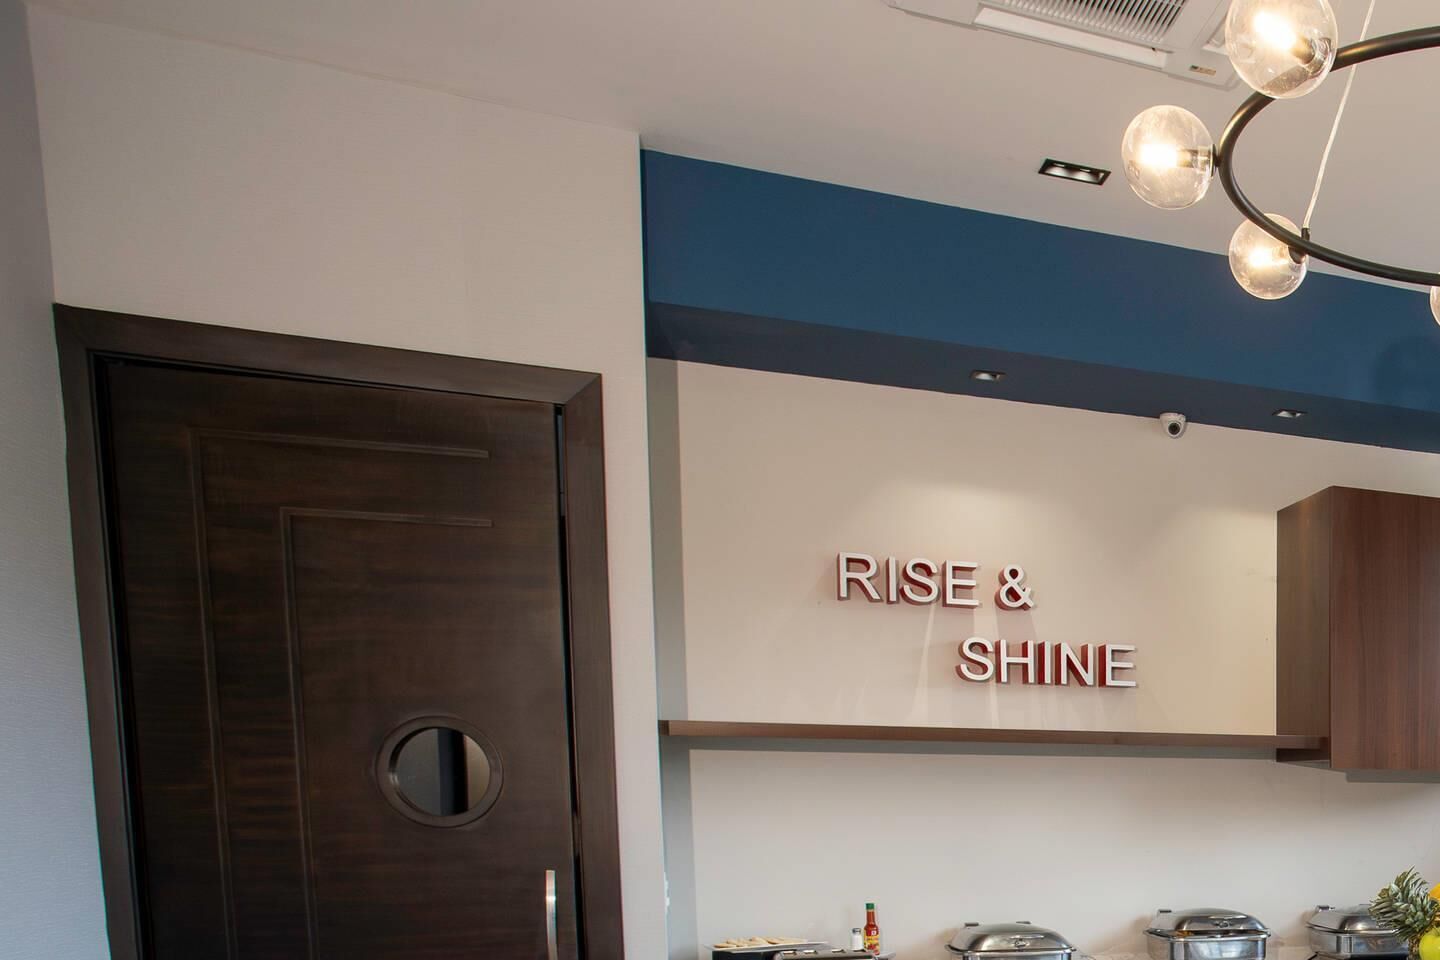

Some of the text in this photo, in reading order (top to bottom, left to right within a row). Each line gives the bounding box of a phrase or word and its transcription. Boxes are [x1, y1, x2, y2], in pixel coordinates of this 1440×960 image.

[837, 551, 1036, 611] RISE &
[956, 636, 1137, 688] SHINE
